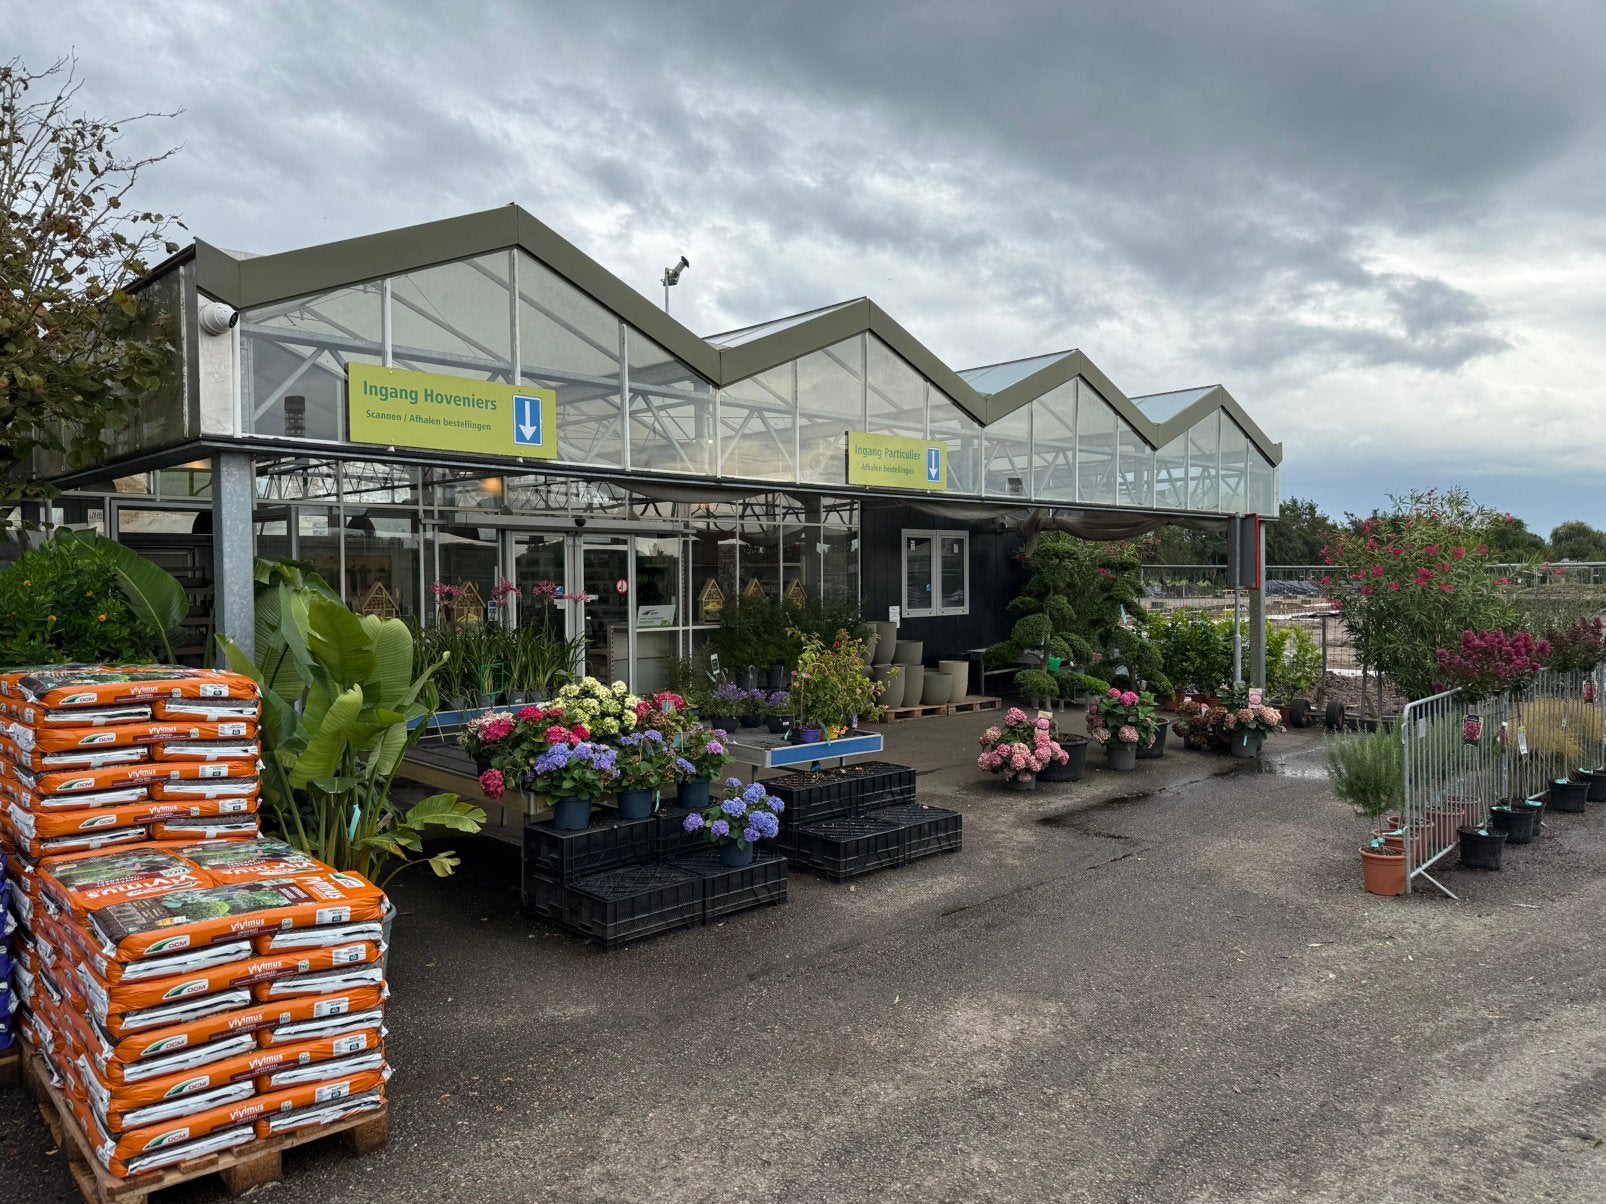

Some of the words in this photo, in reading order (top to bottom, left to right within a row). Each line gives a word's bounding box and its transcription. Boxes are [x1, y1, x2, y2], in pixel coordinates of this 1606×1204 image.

[363, 380, 419, 405] Ingang
[424, 388, 497, 411] Hoveniers
[366, 409, 402, 422] Scannen
[409, 414, 441, 426] Afhalen
[443, 417, 492, 431] bestellingen
[855, 444, 882, 459] Ingang
[884, 447, 921, 461] Particulier
[861, 463, 882, 472] Afhalen
[883, 465, 915, 476] bestellingen
[168, 940, 187, 949] DCM
[187, 984, 207, 993] DCM
[165, 1039, 186, 1049] DCM
[187, 1080, 208, 1091] DCM
[167, 1133, 187, 1143] DCM
